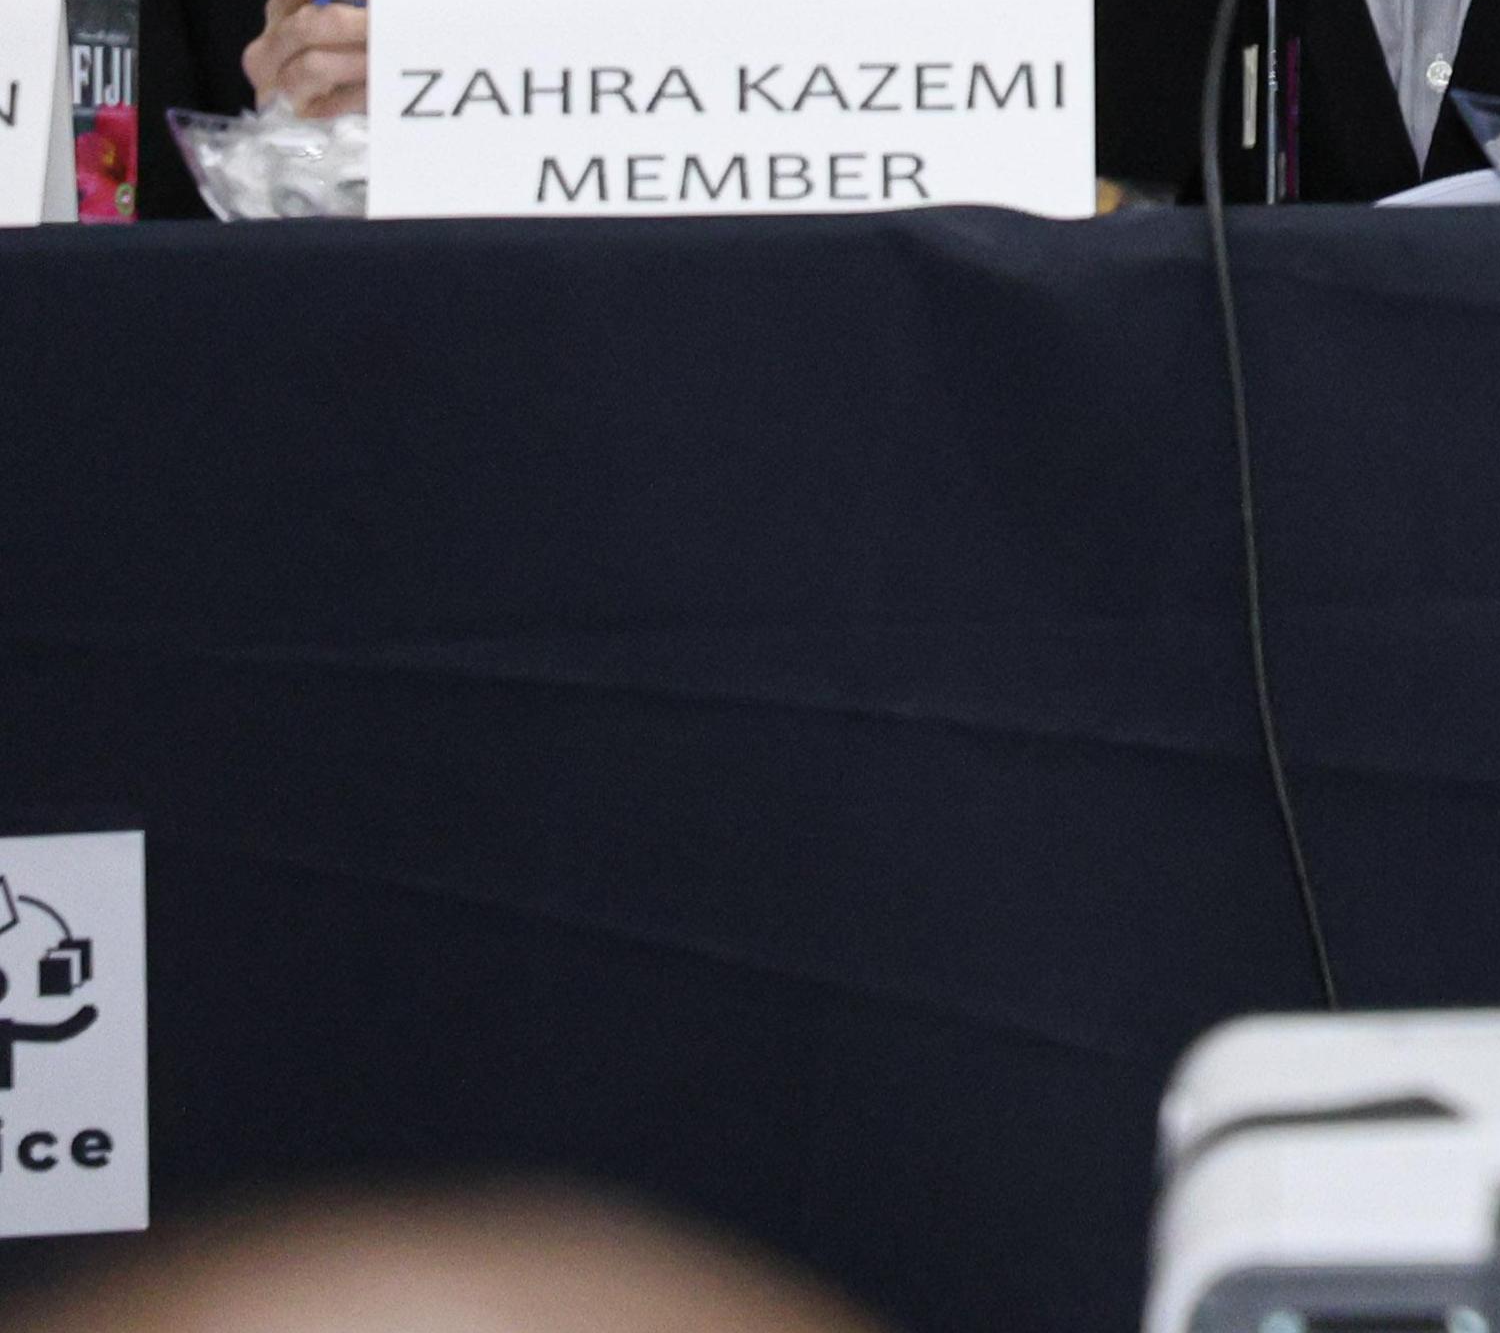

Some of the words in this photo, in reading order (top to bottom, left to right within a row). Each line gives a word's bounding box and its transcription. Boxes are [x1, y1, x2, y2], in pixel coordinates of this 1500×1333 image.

[72, 44, 133, 107] FIJI
[400, 66, 705, 118] ZAHRA
[736, 61, 1065, 113] KAZEMI
[536, 152, 931, 203] MEMBER
[0, 1119, 114, 1173] ce
